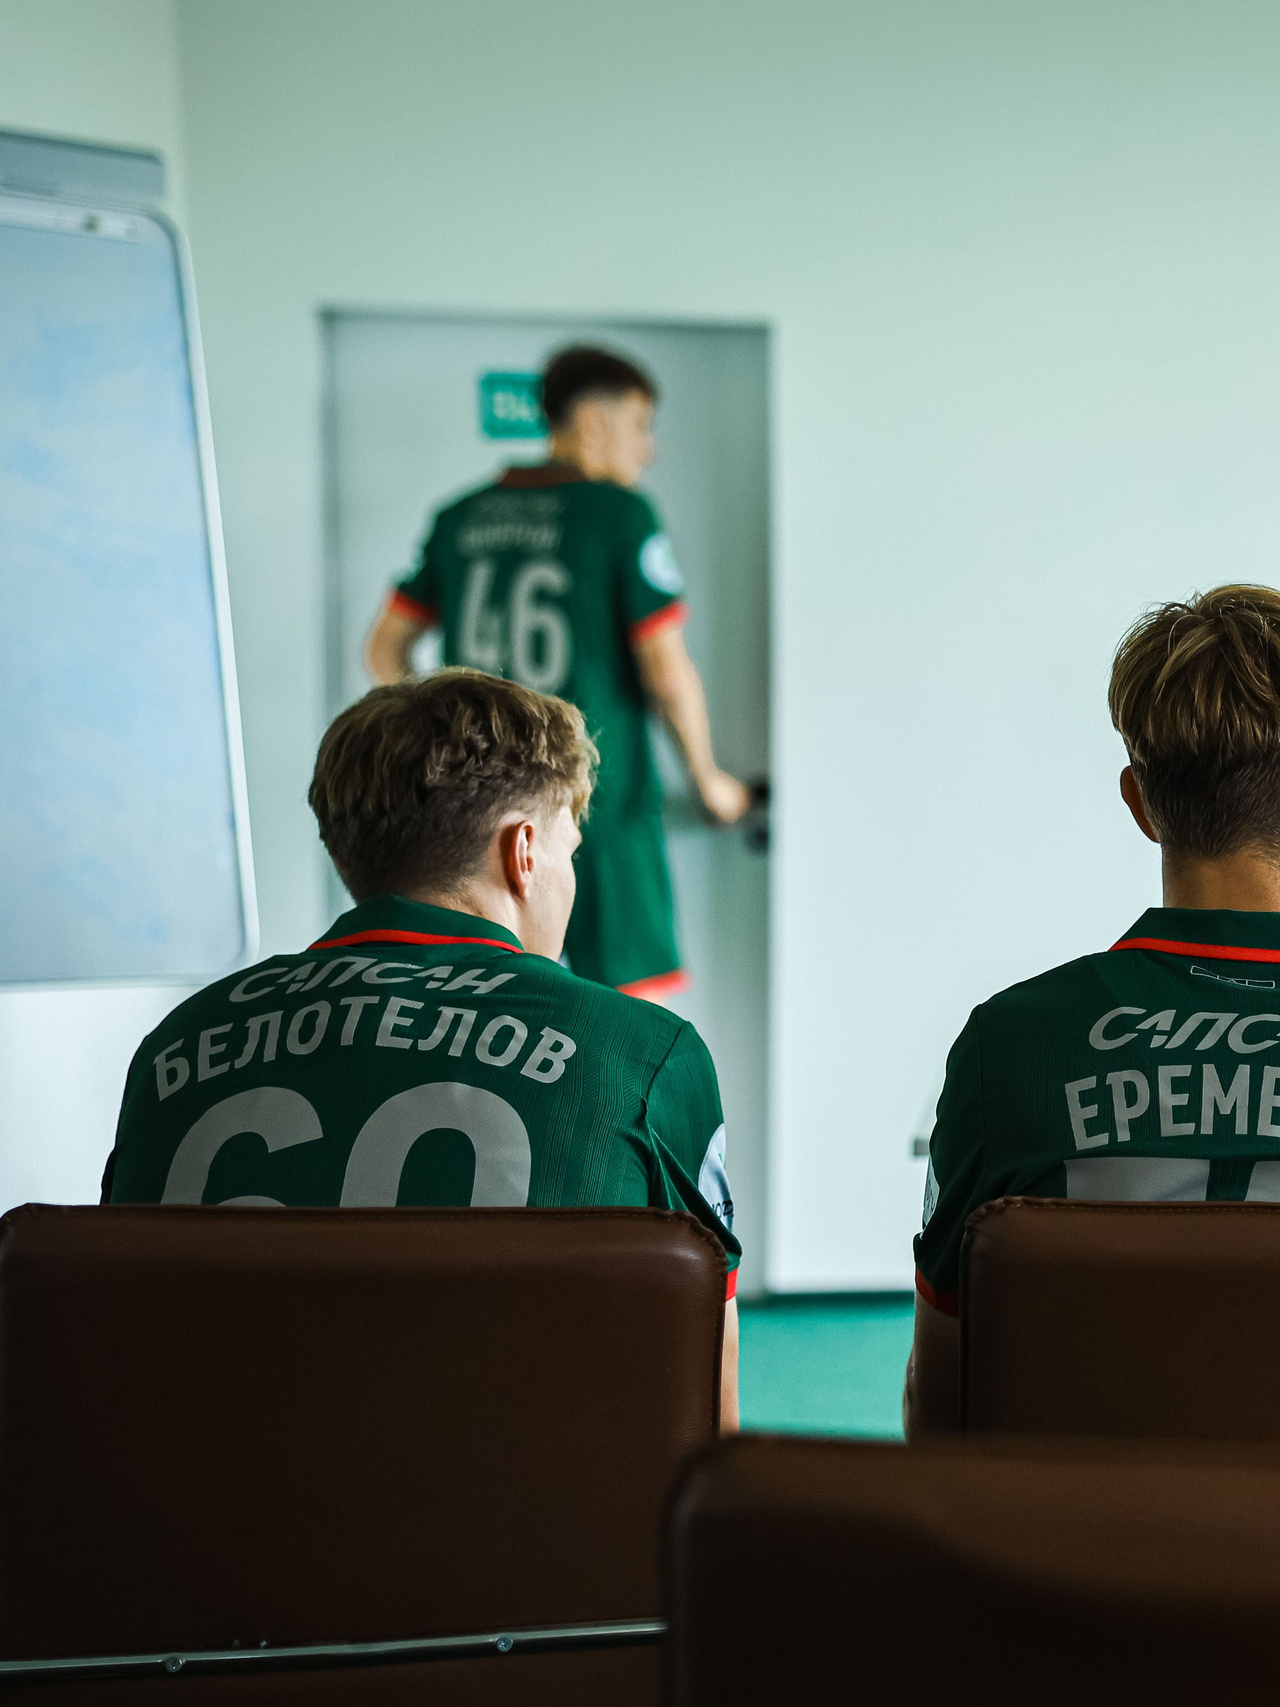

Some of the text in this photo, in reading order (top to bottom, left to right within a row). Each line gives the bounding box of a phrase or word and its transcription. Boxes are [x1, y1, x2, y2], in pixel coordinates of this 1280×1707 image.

[461, 557, 571, 697] 46
[229, 957, 518, 1002] САПСАН
[153, 997, 577, 1101] БЕЛОТЕЛОВ
